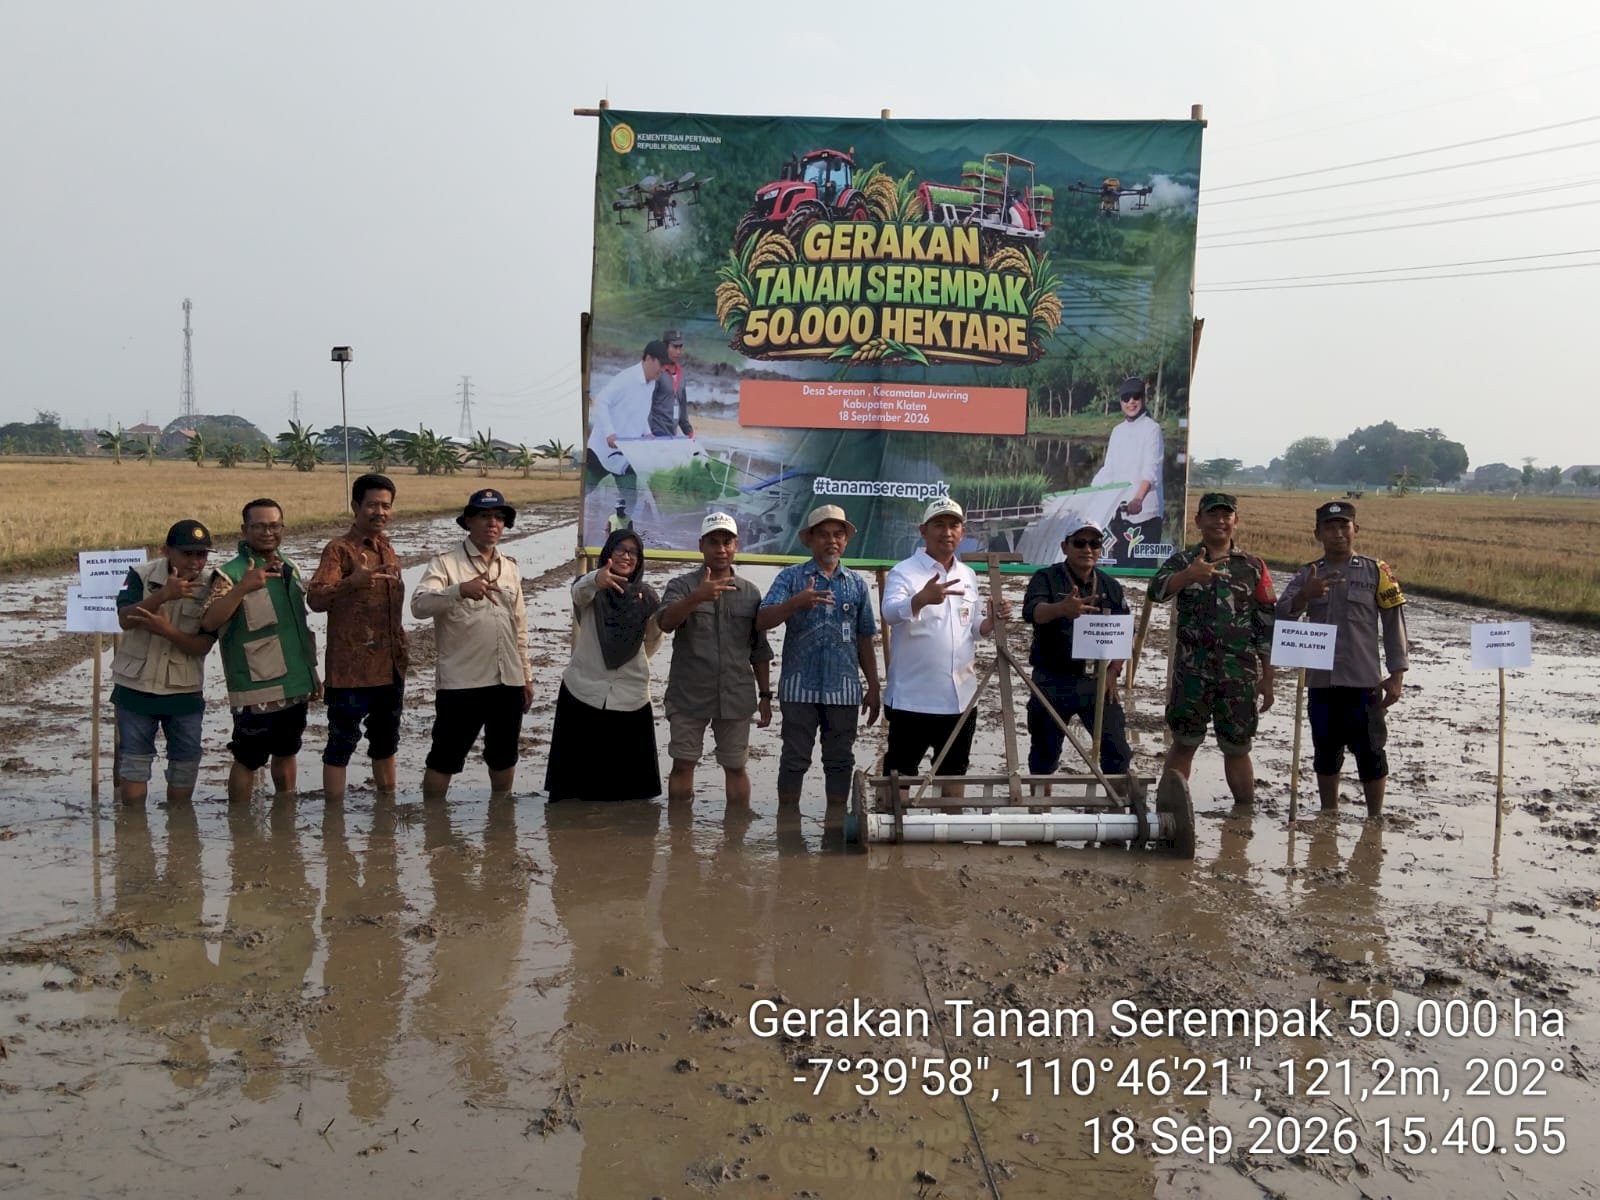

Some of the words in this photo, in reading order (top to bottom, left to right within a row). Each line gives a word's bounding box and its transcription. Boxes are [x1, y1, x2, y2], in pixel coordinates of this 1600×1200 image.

[637, 133, 684, 143] KEMENTERIAN
[684, 136, 722, 144] PERTANIAN
[803, 223, 980, 265] GERAKAN
[755, 266, 864, 306] TANAM
[866, 265, 1028, 315] SEREMPAK
[743, 307, 875, 347] 50.000
[881, 307, 1028, 356] HEKTARE
[802, 385, 825, 396] Desa
[826, 385, 865, 396] Serenan
[873, 386, 926, 399] Kecamatan
[927, 389, 969, 403] Juwiring
[843, 399, 894, 412] Kabupaten
[896, 400, 927, 411] Klaten
[839, 411, 848, 421] 18
[851, 412, 901, 424] September
[904, 413, 930, 424] 2026
[814, 478, 949, 501] #tanamserempak
[1281, 628, 1308, 636] KEPALA
[1299, 642, 1326, 650] KLATEN
